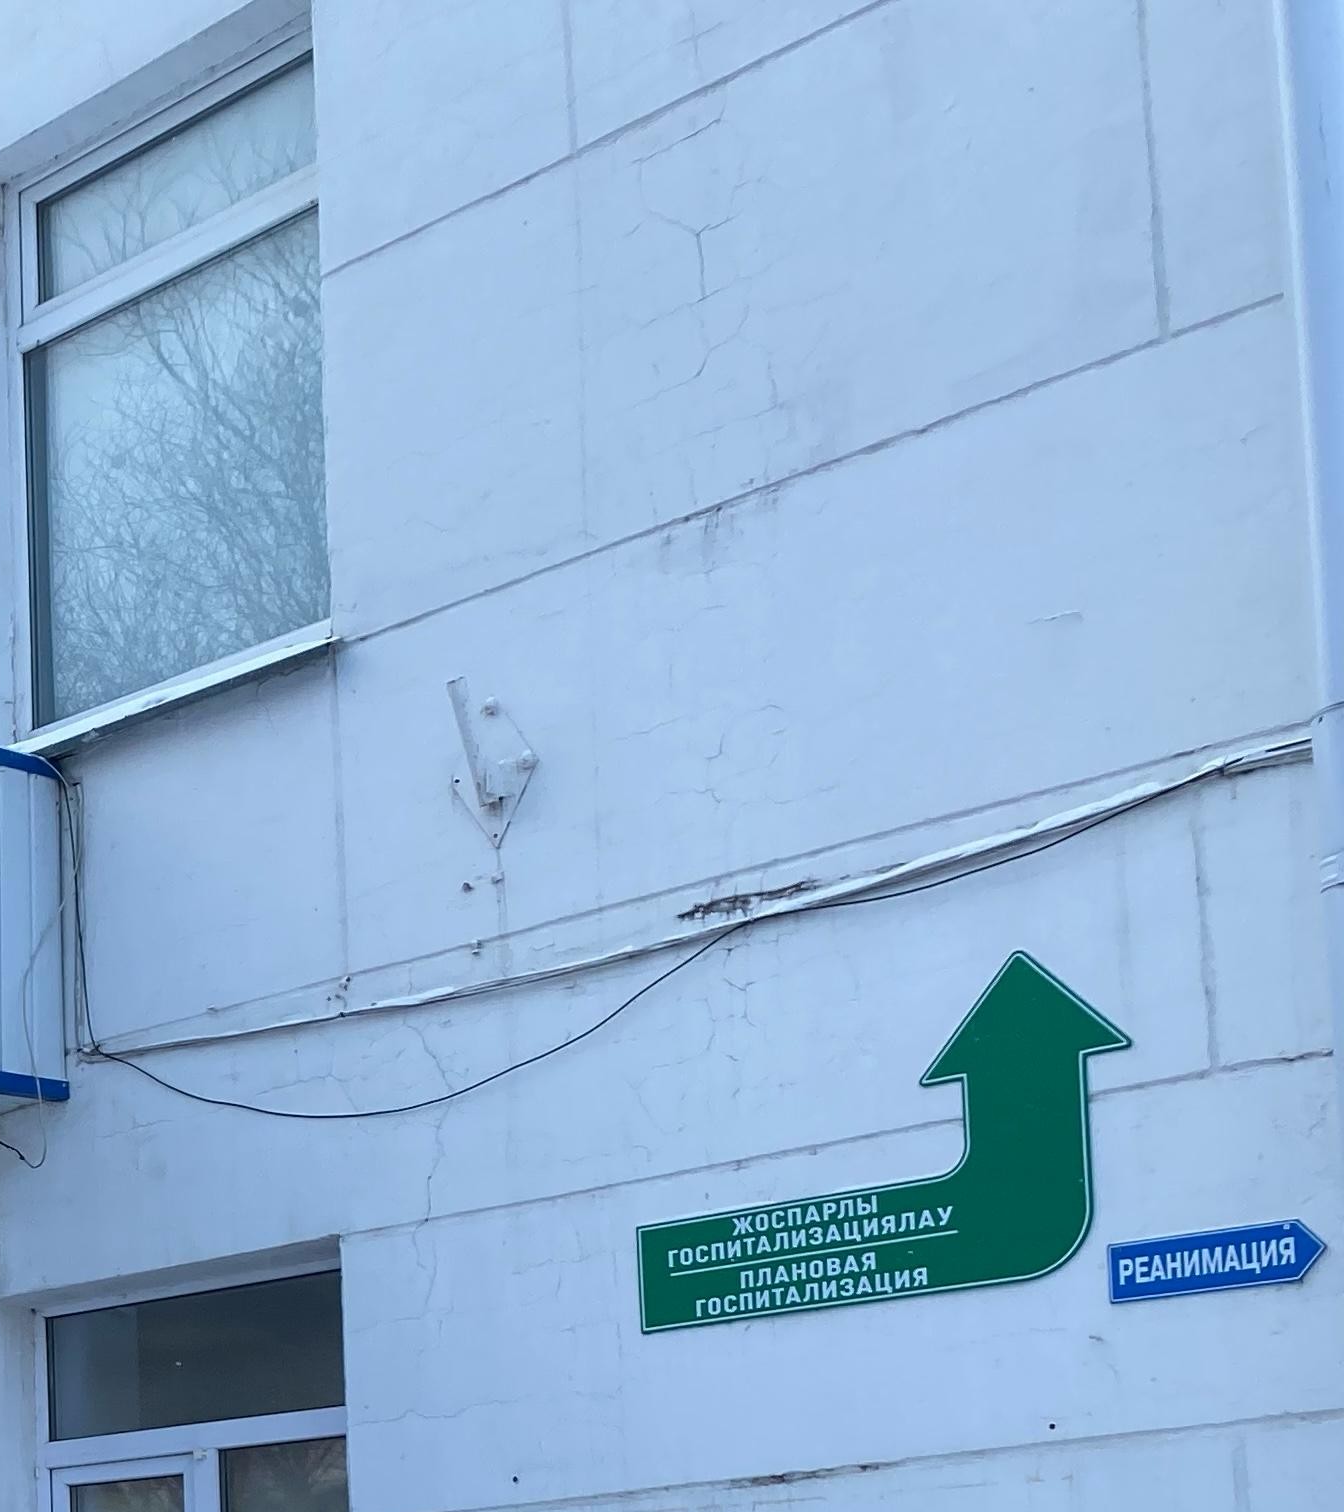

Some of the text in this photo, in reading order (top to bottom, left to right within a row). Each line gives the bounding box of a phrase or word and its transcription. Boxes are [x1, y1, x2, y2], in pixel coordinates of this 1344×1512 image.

[667, 1205, 953, 1268] ГОСПИТАЛИЗАЦИЯЛАУ
[732, 1195, 879, 1236] ЖОСПАРЛЫ
[739, 1251, 877, 1289] ПЛАНОВАЯ
[1118, 1235, 1296, 1286] РЕАНИМАЦИЯ
[695, 1267, 929, 1319] ГОСПИТАЛИЗАЦИЯ
